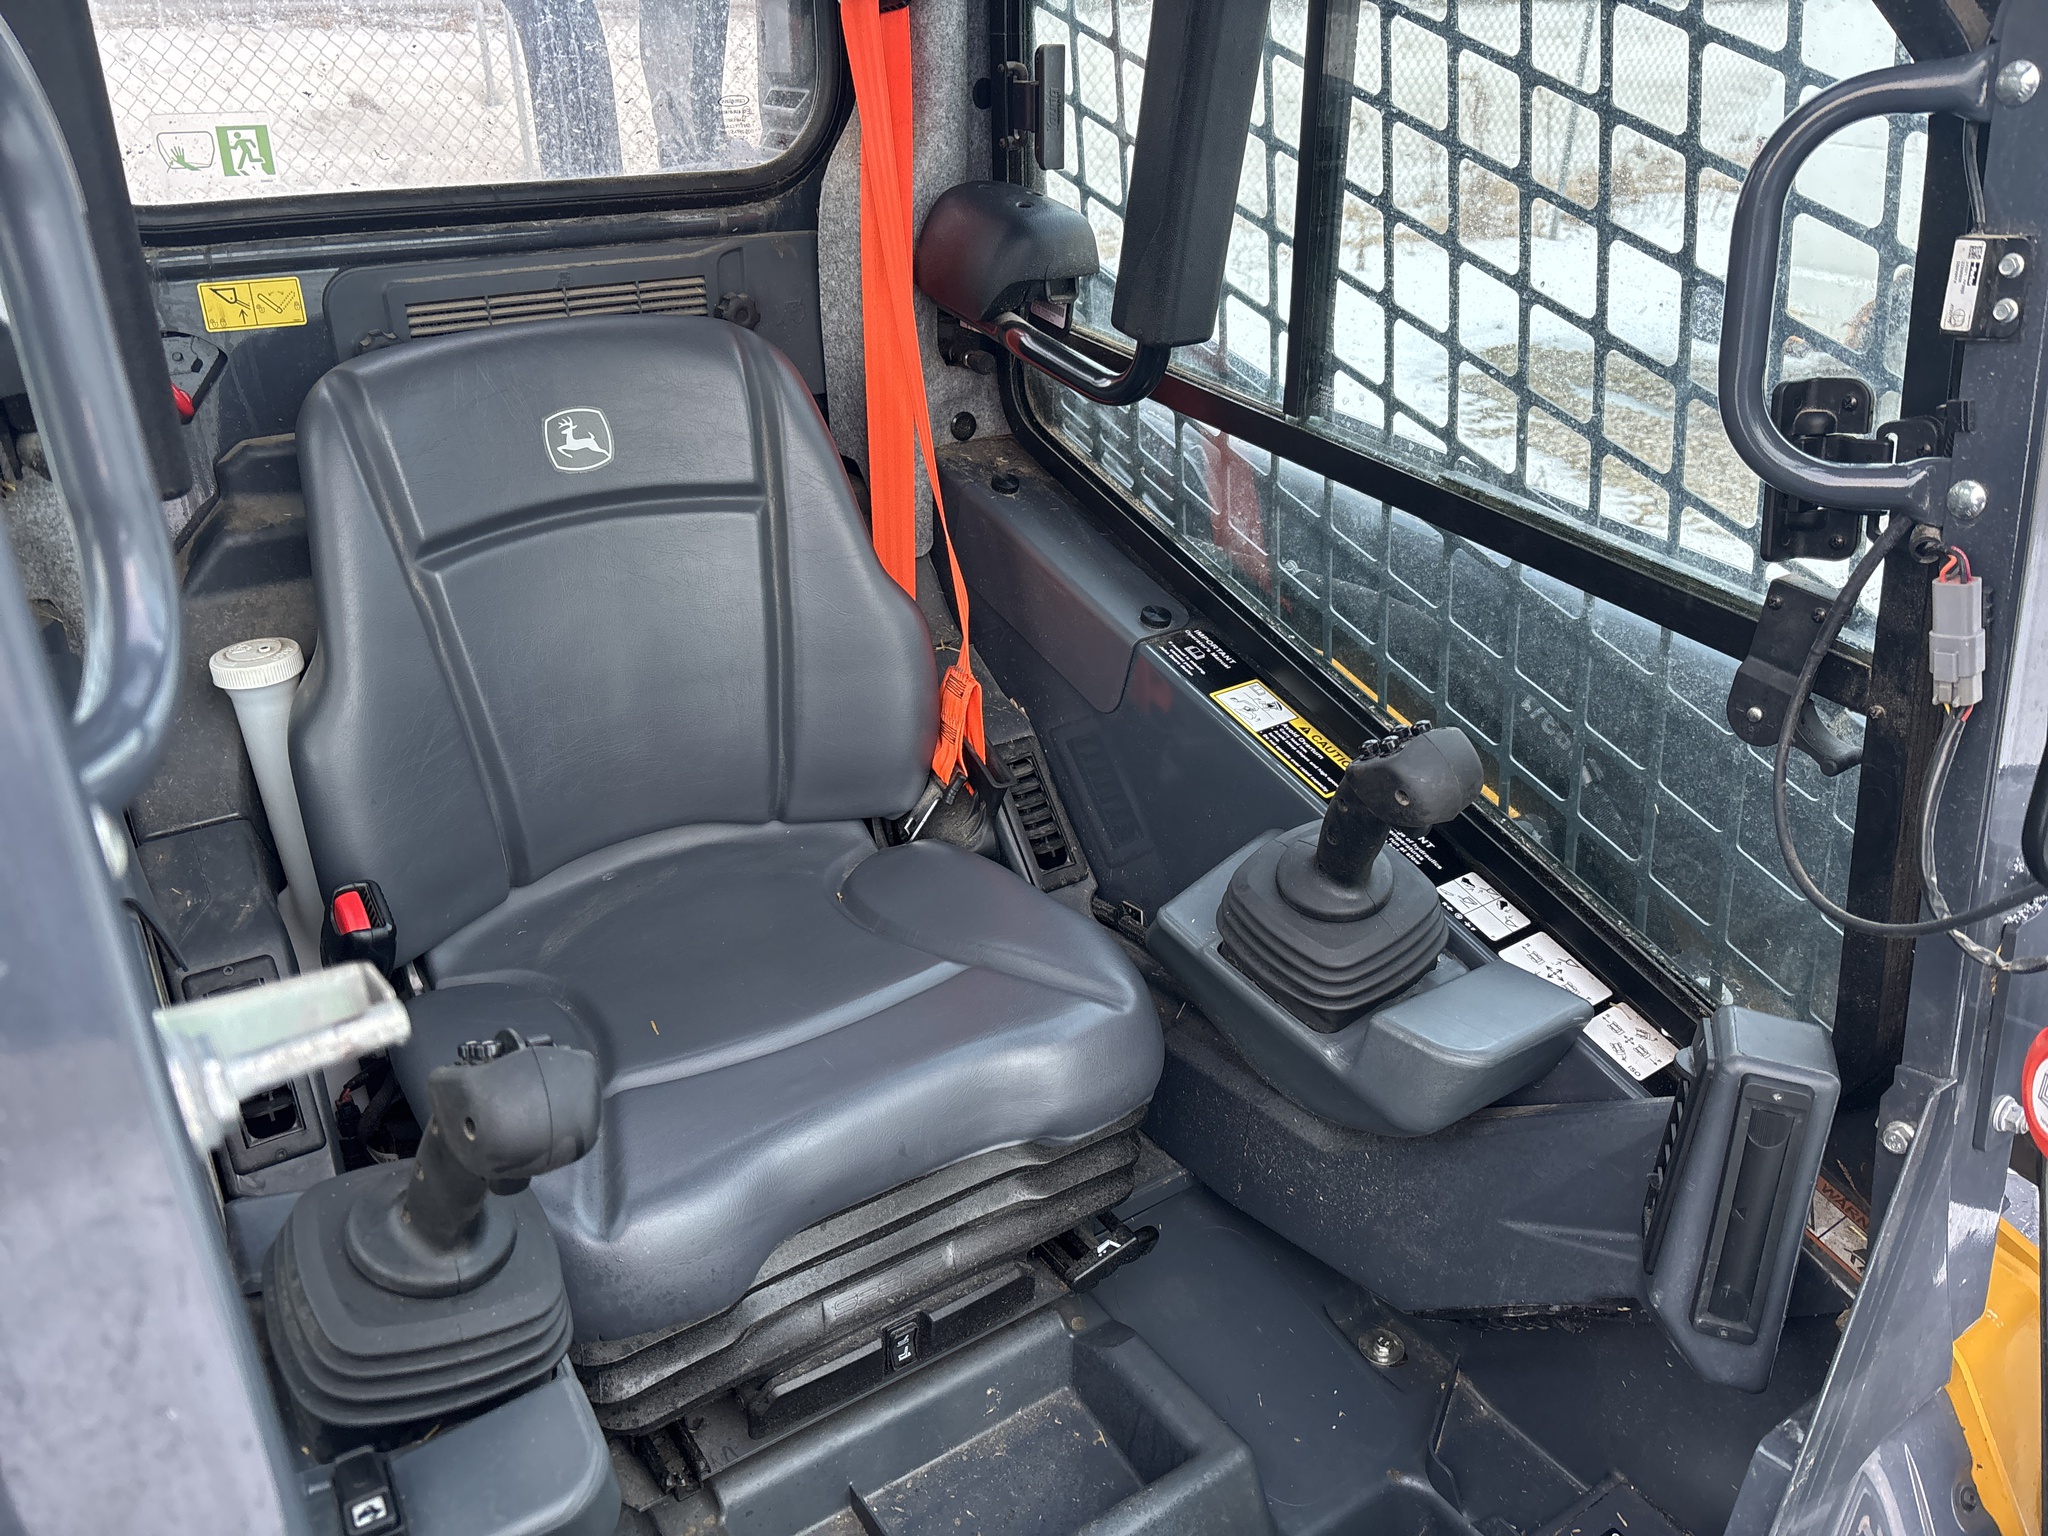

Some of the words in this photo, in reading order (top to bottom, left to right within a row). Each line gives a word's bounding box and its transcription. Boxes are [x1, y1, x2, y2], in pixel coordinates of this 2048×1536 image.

[1169, 654, 1181, 665] Deere
[1185, 629, 1211, 653] Operator's
[1210, 652, 1231, 669] Manual
[1194, 629, 1237, 664] IMPORTANT
[1273, 730, 1286, 741] Avoid
[1296, 749, 1310, 762] slopes
[1275, 745, 1291, 759] operate
[1281, 723, 1300, 738] Avoid
[1298, 737, 1324, 760] Overturn
[1311, 734, 1350, 768] CAUTIO
[1388, 829, 1424, 861] emperatures
[1388, 837, 1400, 847] run
[1405, 852, 1421, 865] slow
[1412, 843, 1442, 870] hydraulics
[1627, 1065, 1641, 1077] ISO
[1822, 1183, 1868, 1230] WARN
